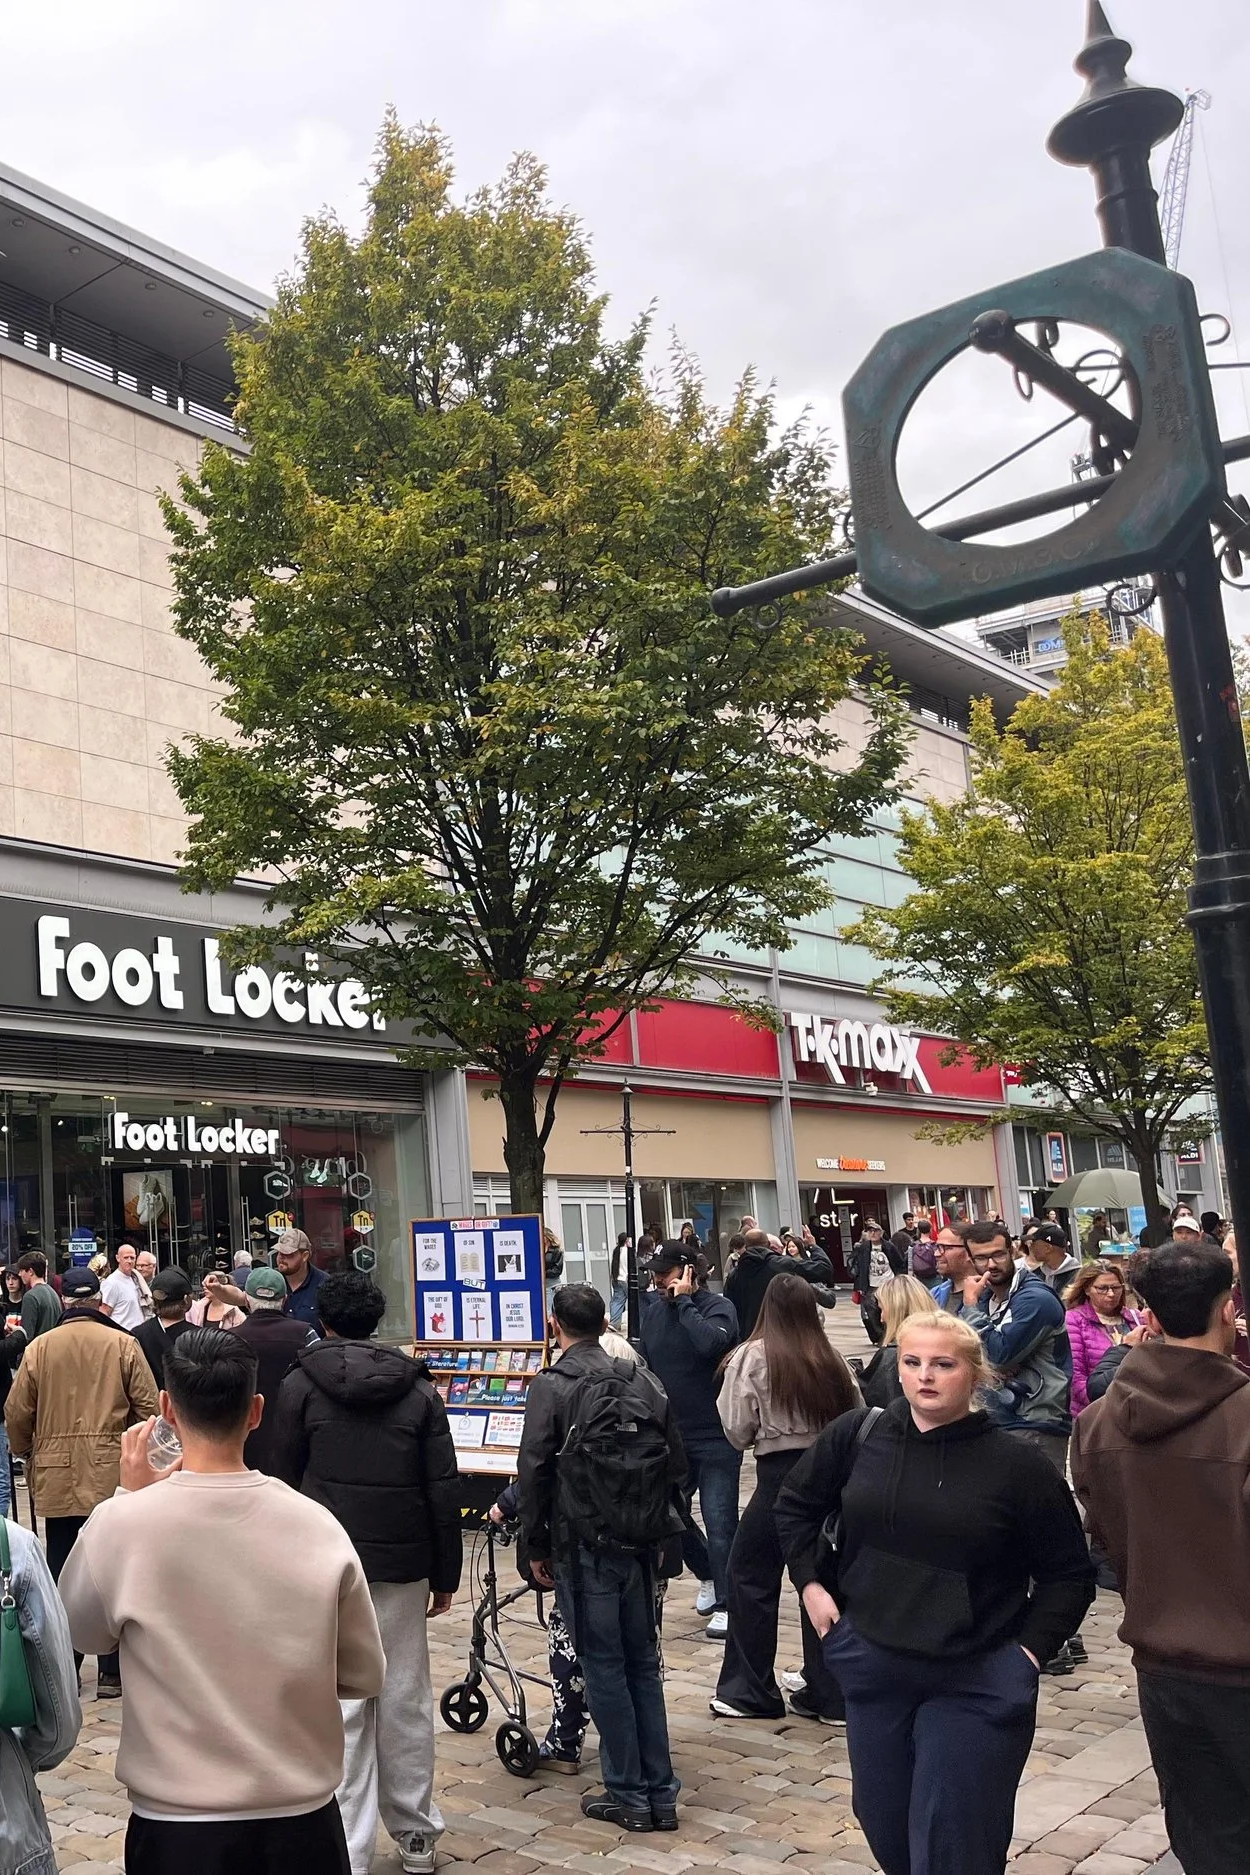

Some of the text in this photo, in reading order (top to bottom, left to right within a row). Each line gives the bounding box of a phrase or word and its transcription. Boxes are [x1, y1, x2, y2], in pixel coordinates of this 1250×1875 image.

[36, 915, 184, 1010] Foot
[114, 1112, 279, 1155] Foot Locker
[820, 1211, 858, 1227] str
[463, 1278, 485, 1289] BUT
